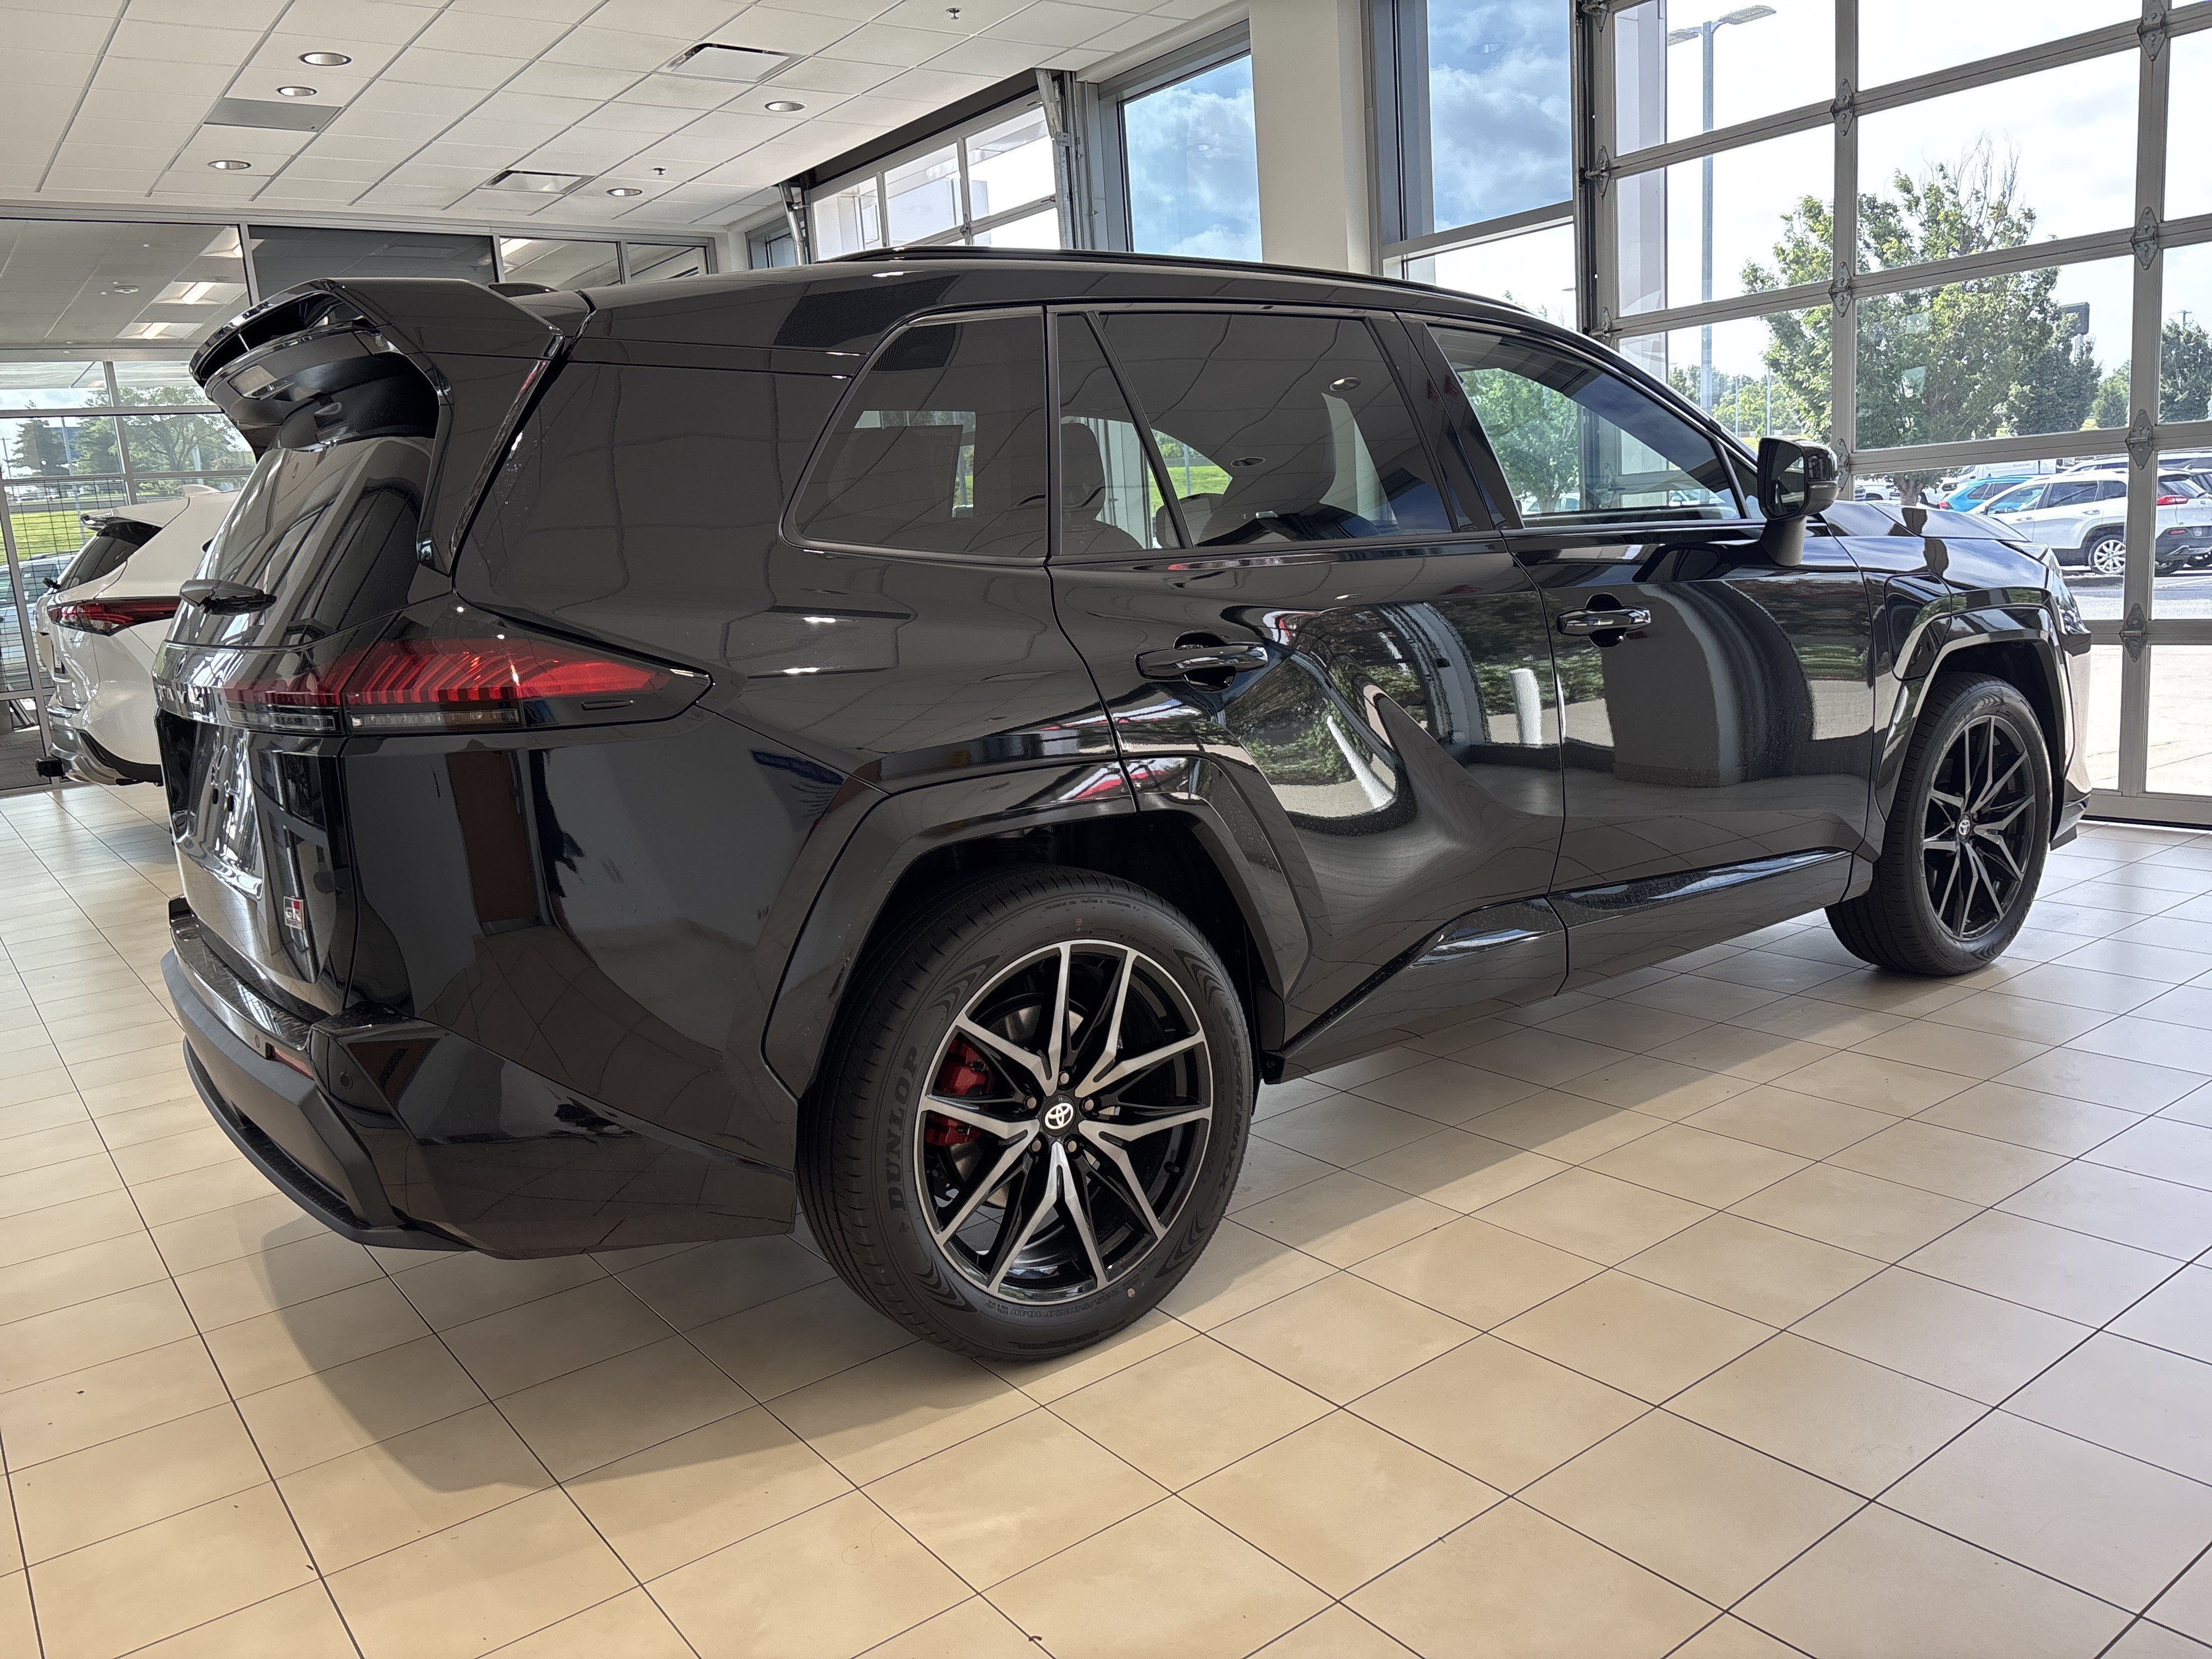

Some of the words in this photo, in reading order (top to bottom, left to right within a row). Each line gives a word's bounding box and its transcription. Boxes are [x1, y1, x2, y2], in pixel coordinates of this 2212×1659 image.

[285, 901, 301, 922] GR
[286, 918, 301, 928] SPORT
[1231, 1037, 1243, 1111] SPORT
[886, 1046, 918, 1211] DUNLOP
[1218, 1112, 1242, 1192] MAXX
